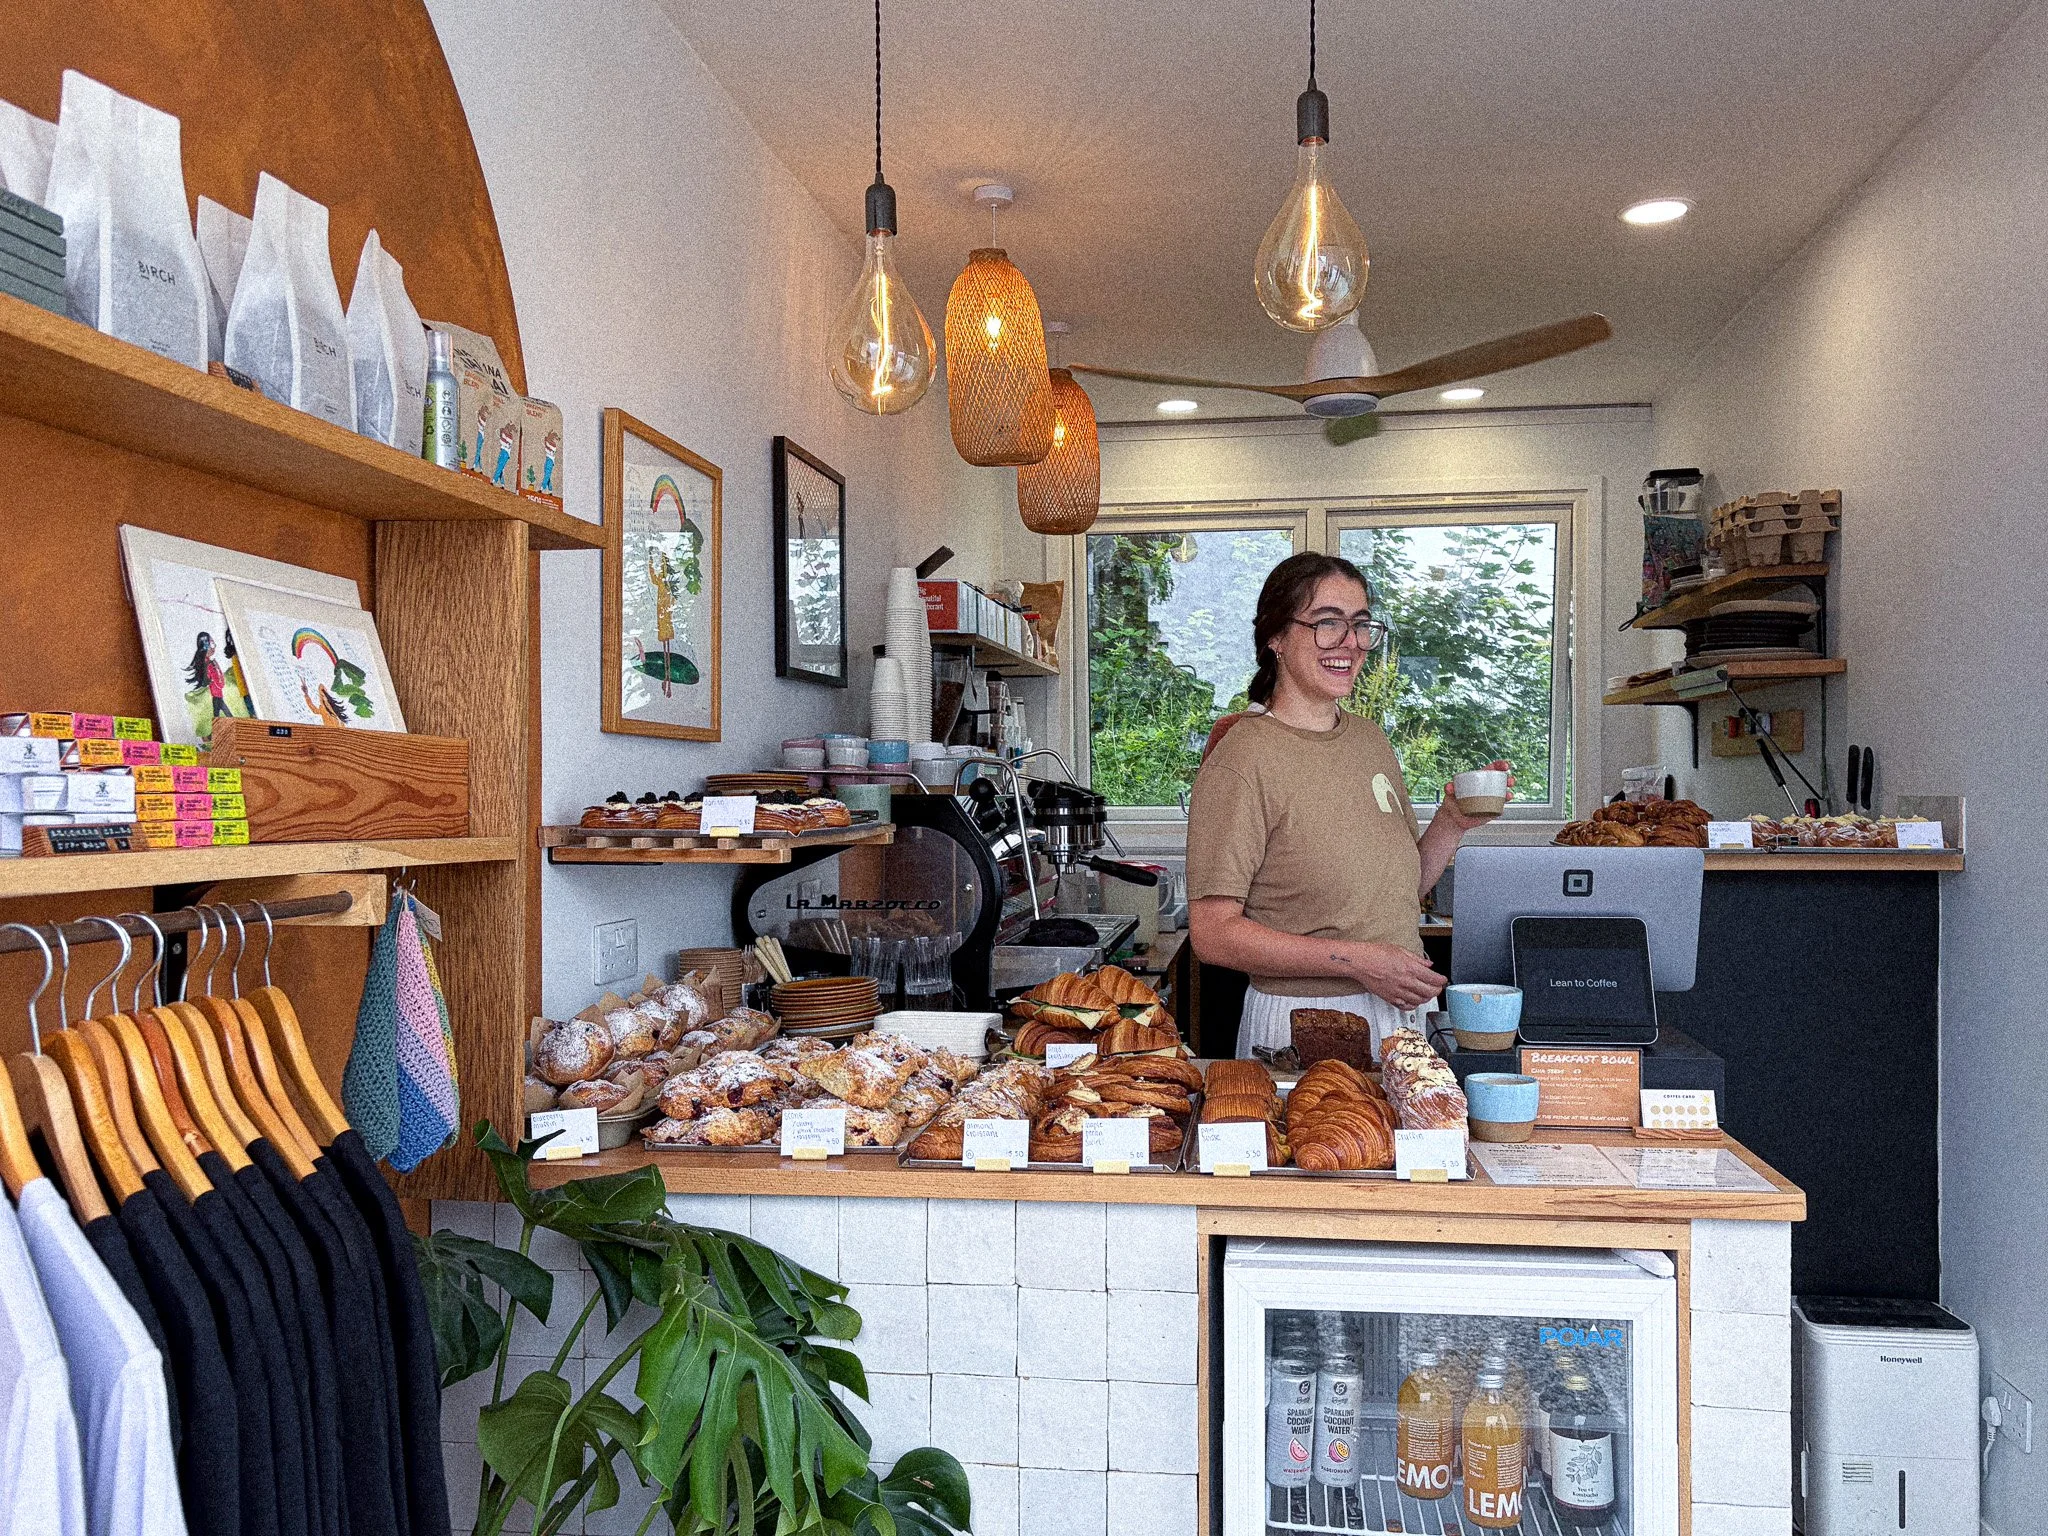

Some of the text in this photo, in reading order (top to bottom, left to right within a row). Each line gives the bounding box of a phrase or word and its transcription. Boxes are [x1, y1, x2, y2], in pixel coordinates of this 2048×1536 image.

[138, 260, 176, 285] BIRCH
[1550, 978, 1618, 988] Lean to Coffee
[1530, 1052, 1636, 1065] BREAKFAST BOWL
[966, 1122, 995, 1130] almond
[965, 1130, 999, 1138] croissant
[1539, 1323, 1624, 1347] POLAR
[1880, 1355, 1923, 1365] Honeywell
[1323, 1406, 1355, 1417] SPARKLING
[1323, 1414, 1355, 1425] COCONUT
[1291, 1425, 1311, 1435] WATER
[1327, 1424, 1351, 1435] WATER
[1397, 1456, 1453, 1490] EMO
